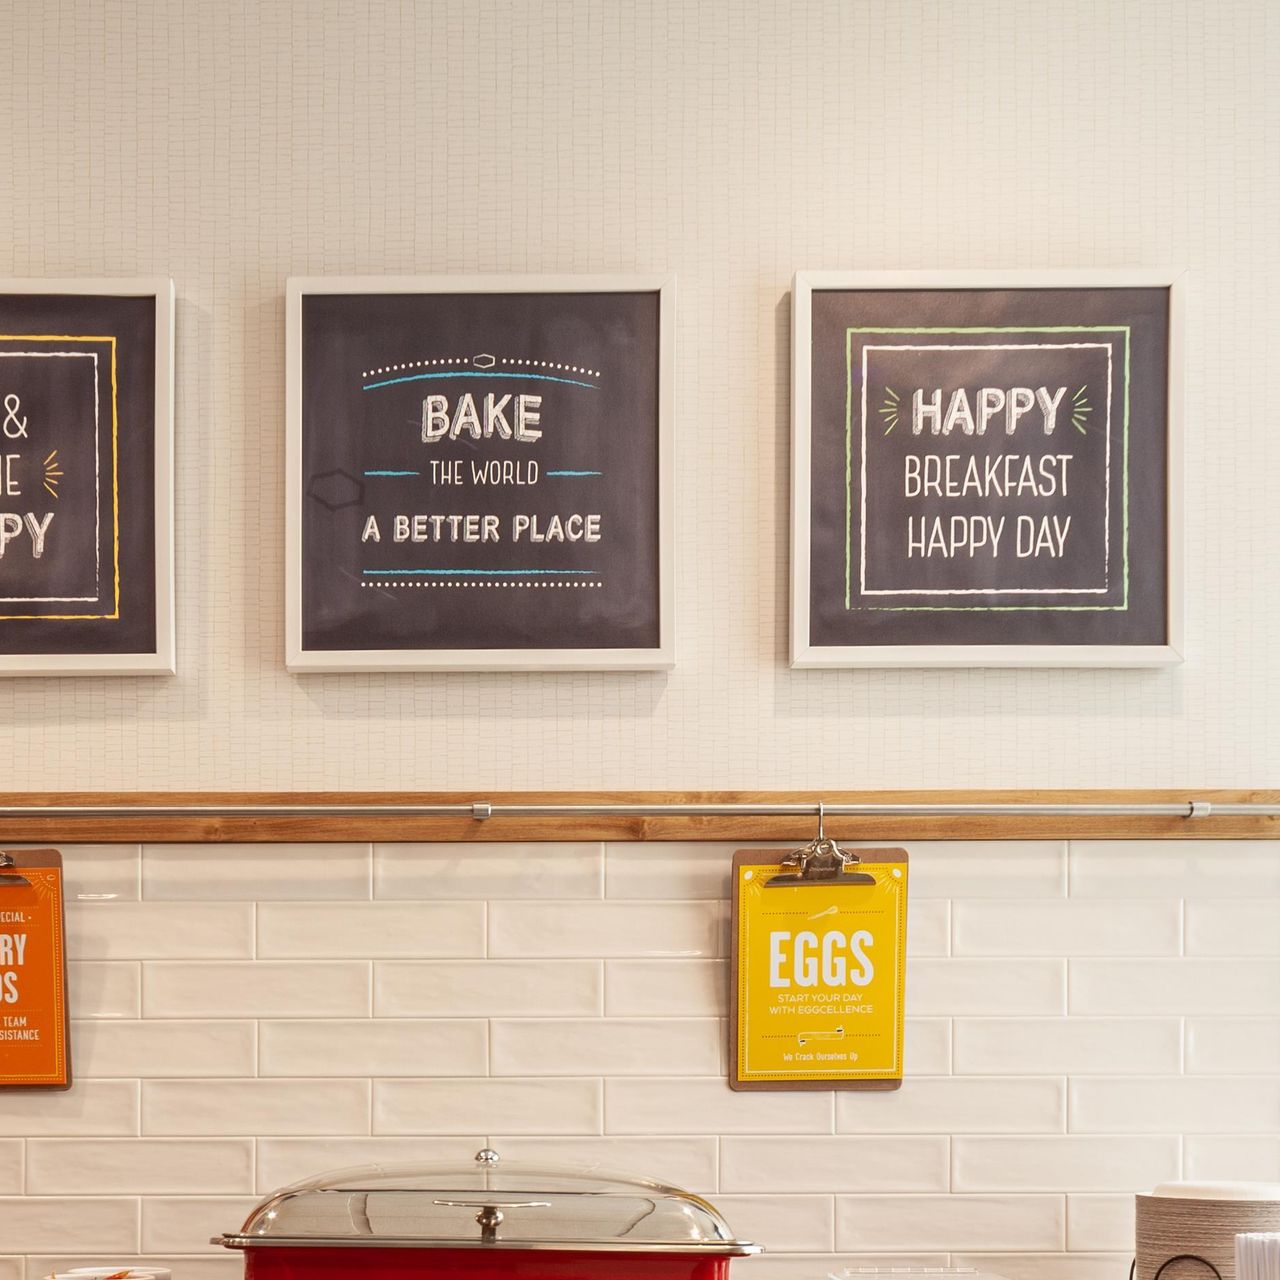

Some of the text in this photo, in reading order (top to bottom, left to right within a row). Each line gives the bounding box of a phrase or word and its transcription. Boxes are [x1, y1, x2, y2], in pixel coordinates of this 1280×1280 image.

[3, 394, 28, 438] &
[421, 393, 543, 443] BAKE
[912, 386, 1067, 435] HAPPY
[430, 460, 539, 486] THE WORLD
[905, 454, 1073, 497] BREAKFAST
[362, 514, 601, 542] A BETTER PLACE
[907, 515, 1071, 558] HAPPY DAY
[770, 930, 874, 987] EGGS
[769, 1005, 873, 1014] WITH EGGCELLENCE
[778, 993, 863, 1003] START YOUR DAY
[3, 1016, 27, 1026] TEAM
